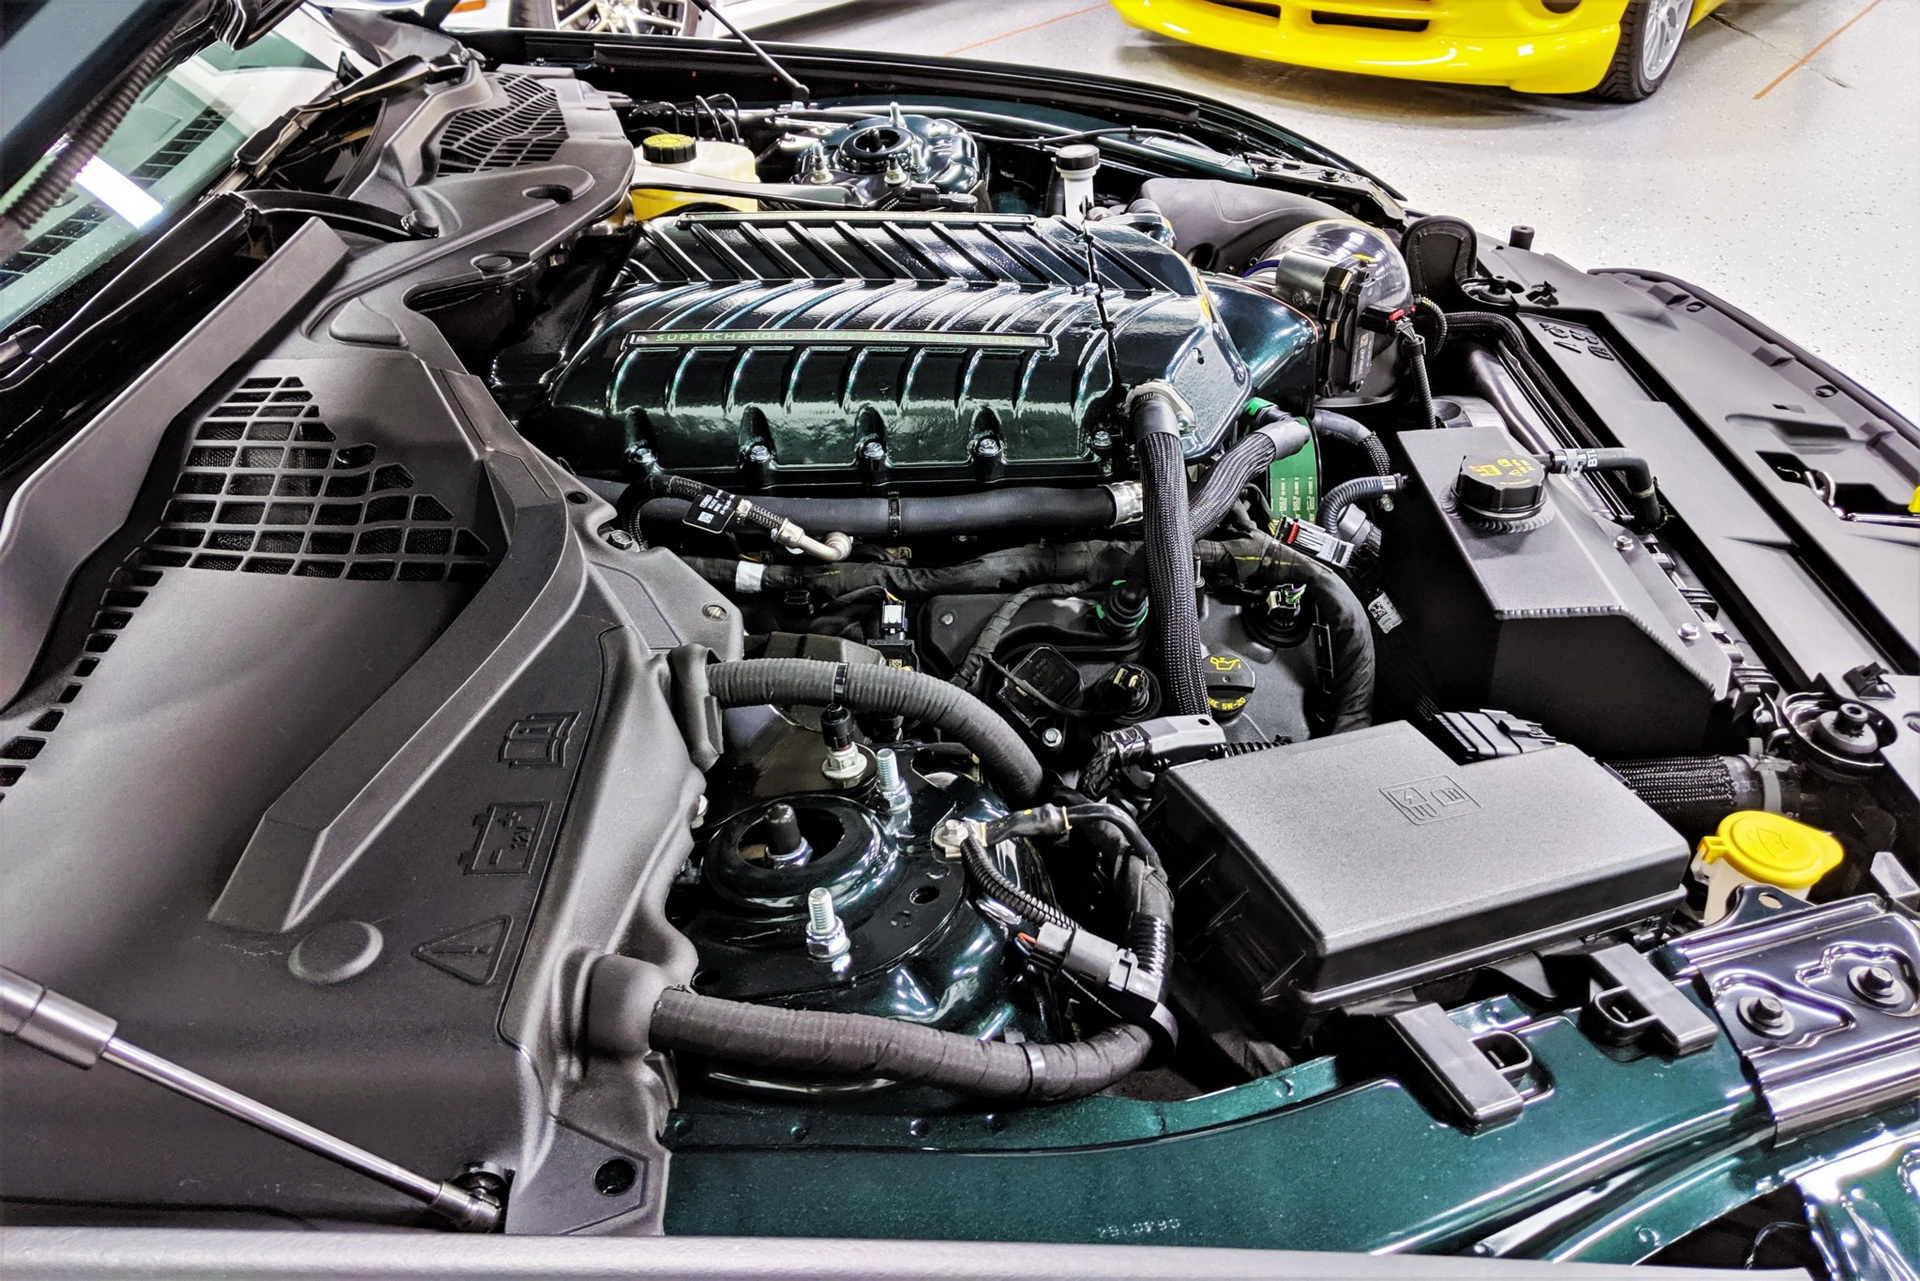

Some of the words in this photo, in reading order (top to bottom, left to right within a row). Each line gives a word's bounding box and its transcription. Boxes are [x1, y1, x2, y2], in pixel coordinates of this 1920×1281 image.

[656, 332, 795, 342] SUPERCHARGED
[803, 332, 856, 341] STEVE
[955, 335, 1027, 345] EDITION
[1221, 697, 1246, 709] 5W-20
